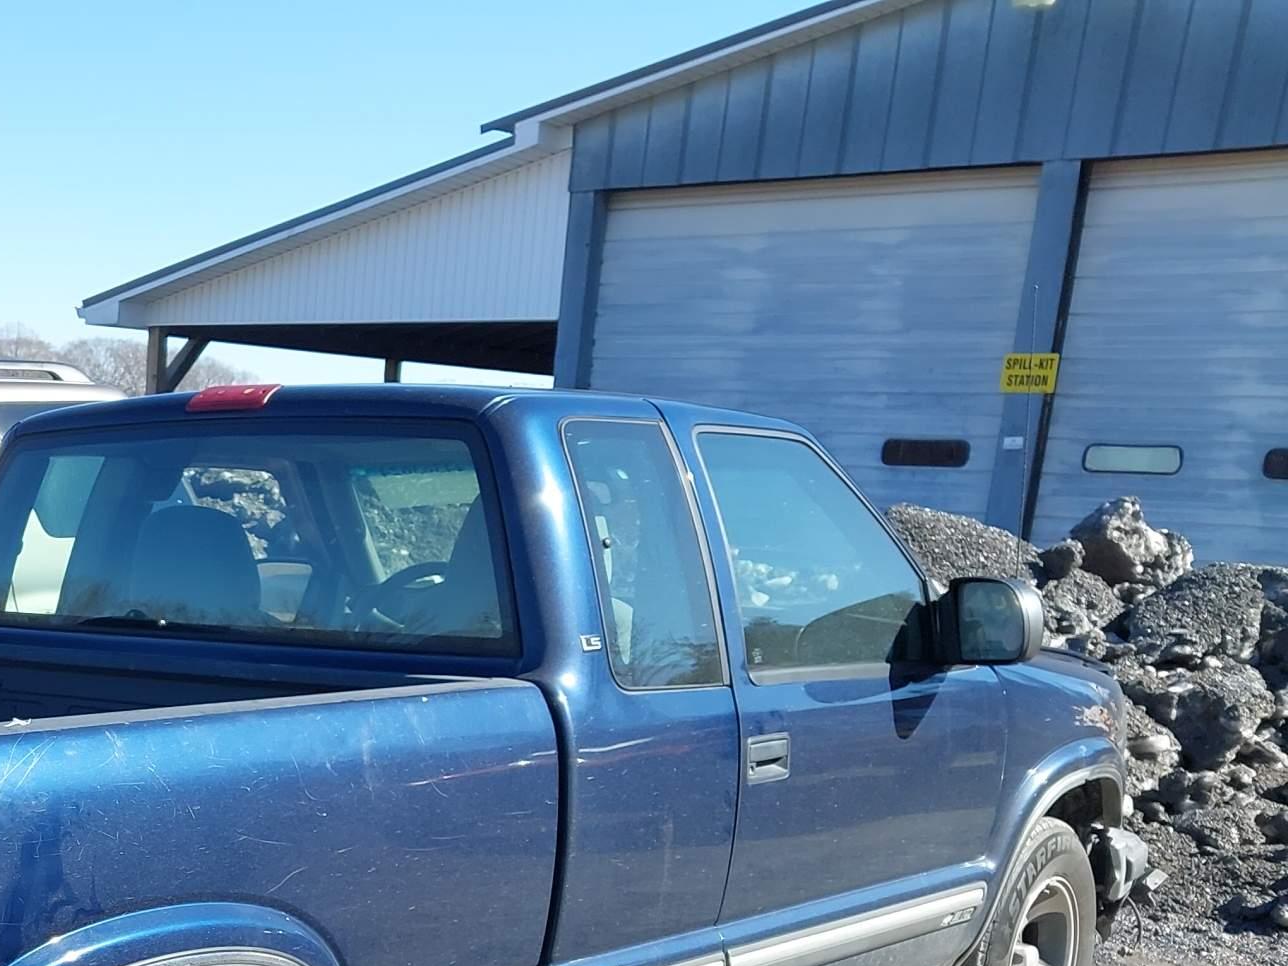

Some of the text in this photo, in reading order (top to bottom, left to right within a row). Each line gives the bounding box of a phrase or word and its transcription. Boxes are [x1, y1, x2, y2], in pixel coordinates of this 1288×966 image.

[1005, 357, 1056, 370] SPILL-KIT
[1006, 374, 1049, 387] STATION
[579, 634, 602, 652] LS
